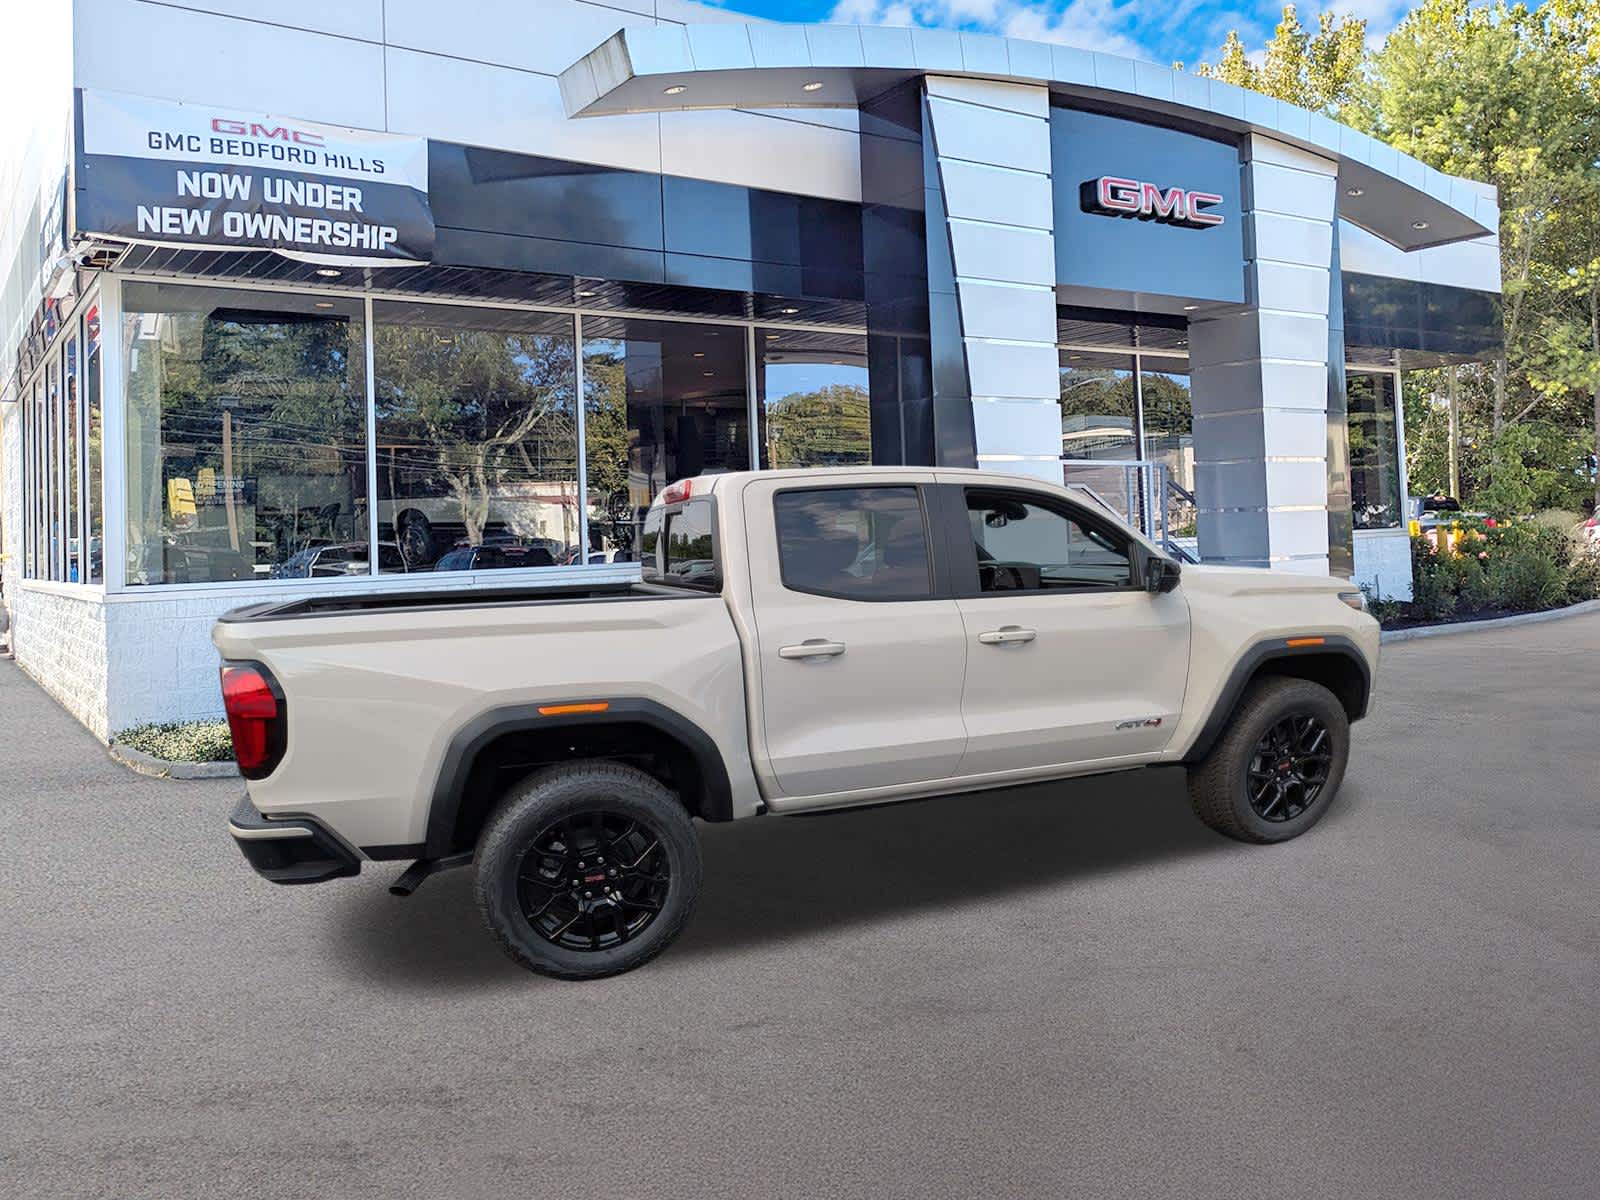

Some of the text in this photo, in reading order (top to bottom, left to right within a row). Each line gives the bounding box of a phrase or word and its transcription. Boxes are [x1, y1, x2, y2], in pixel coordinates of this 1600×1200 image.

[148, 131, 385, 174] GMC BEDFORD HILLS
[211, 118, 326, 148] GMC
[177, 170, 364, 213] NOW UNDER
[1097, 176, 1225, 225] GMC
[136, 205, 398, 250] NEW OWNERSHIP
